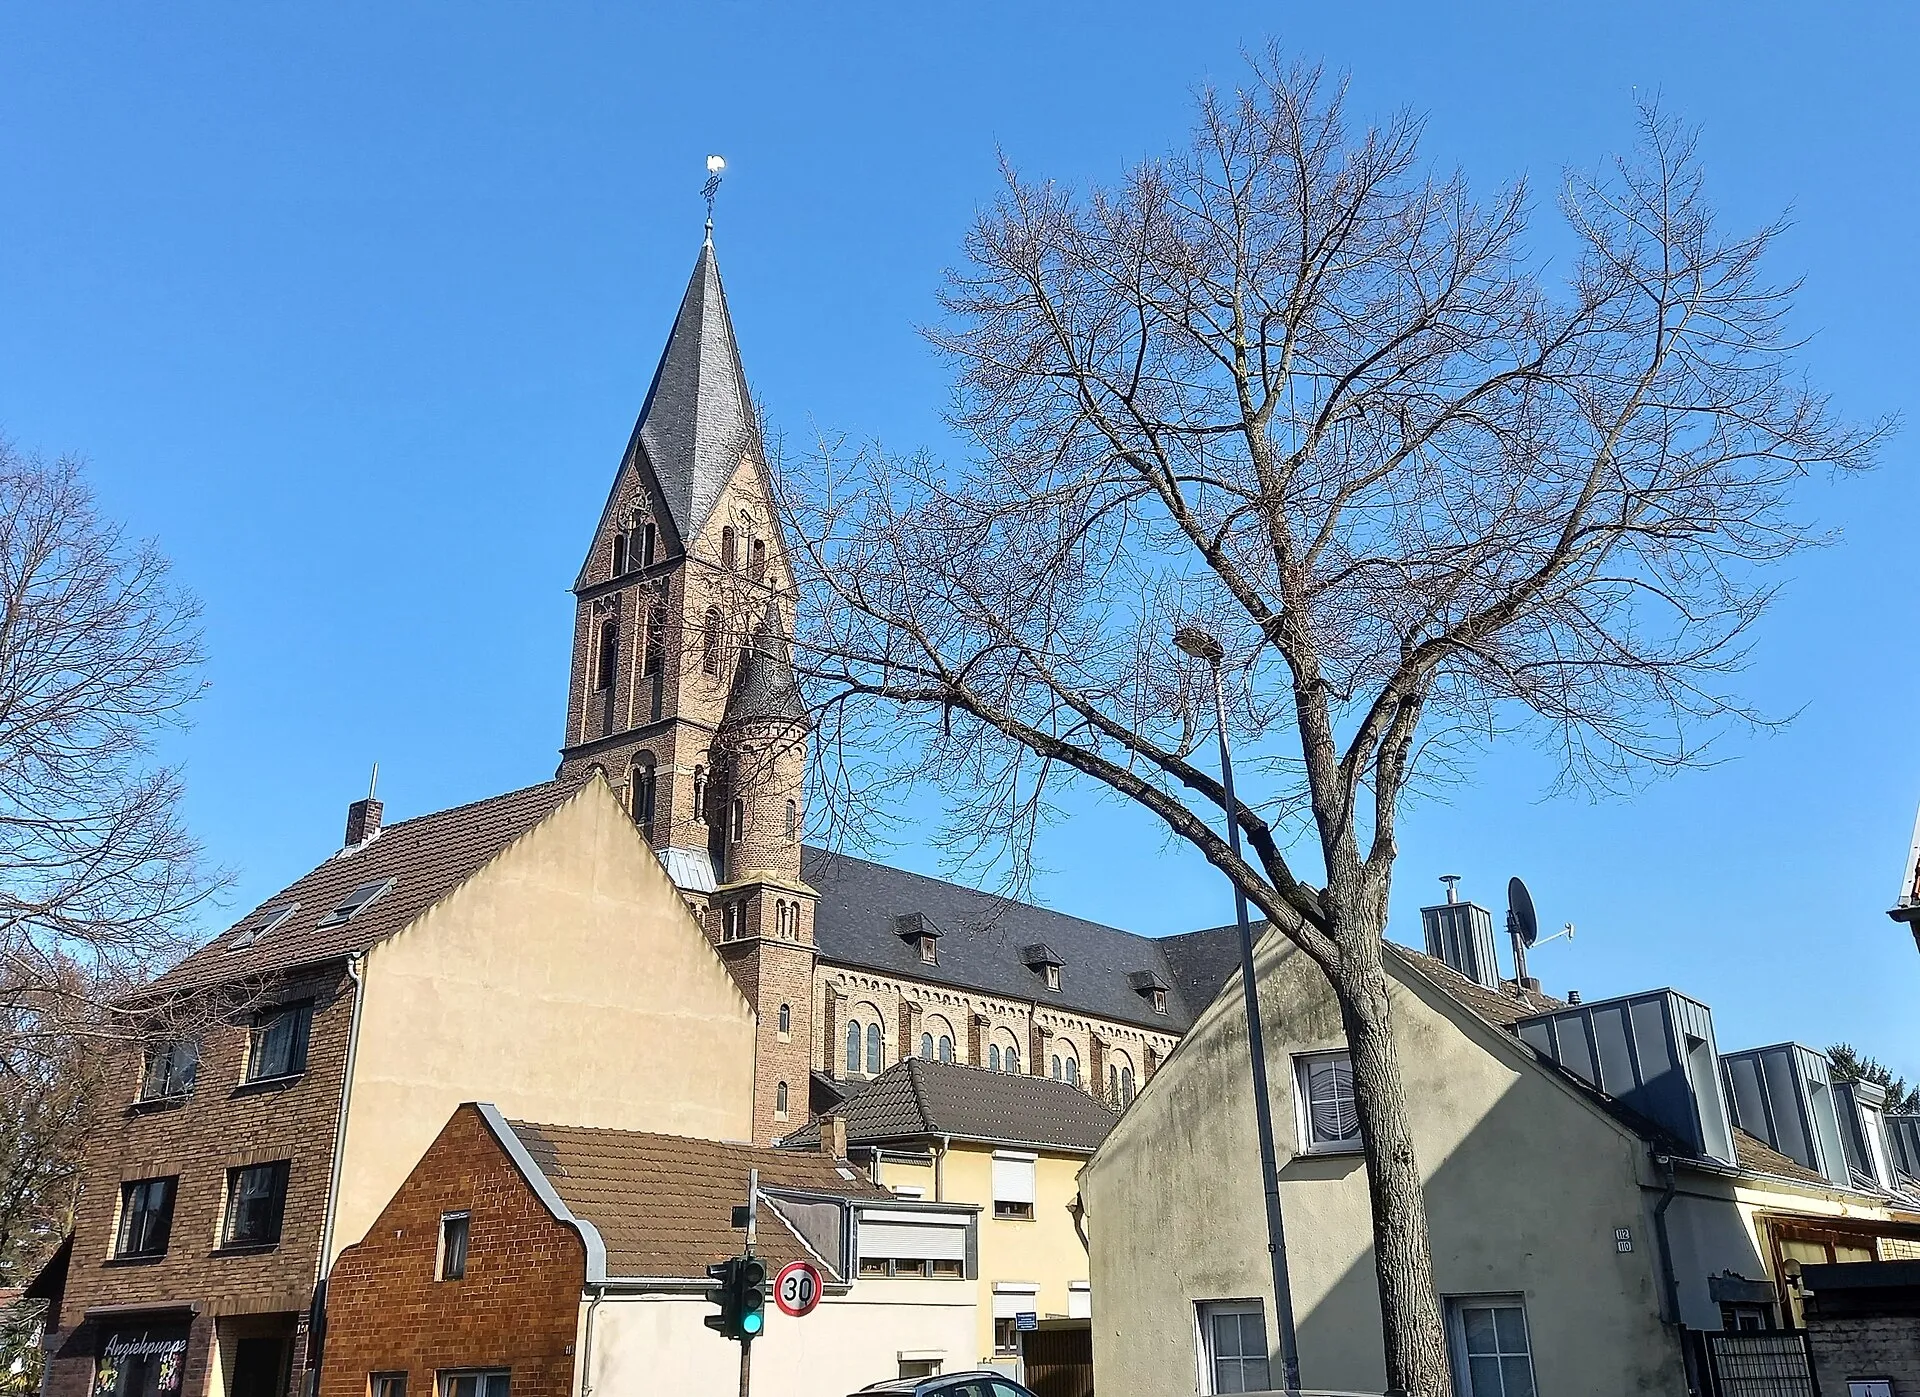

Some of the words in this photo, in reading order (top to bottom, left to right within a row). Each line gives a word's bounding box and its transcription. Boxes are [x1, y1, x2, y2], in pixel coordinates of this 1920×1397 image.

[1617, 1229, 1629, 1239] 112
[1619, 1241, 1630, 1251] 110
[784, 1277, 812, 1302] 30
[104, 1331, 187, 1364] Anziehpuppe
